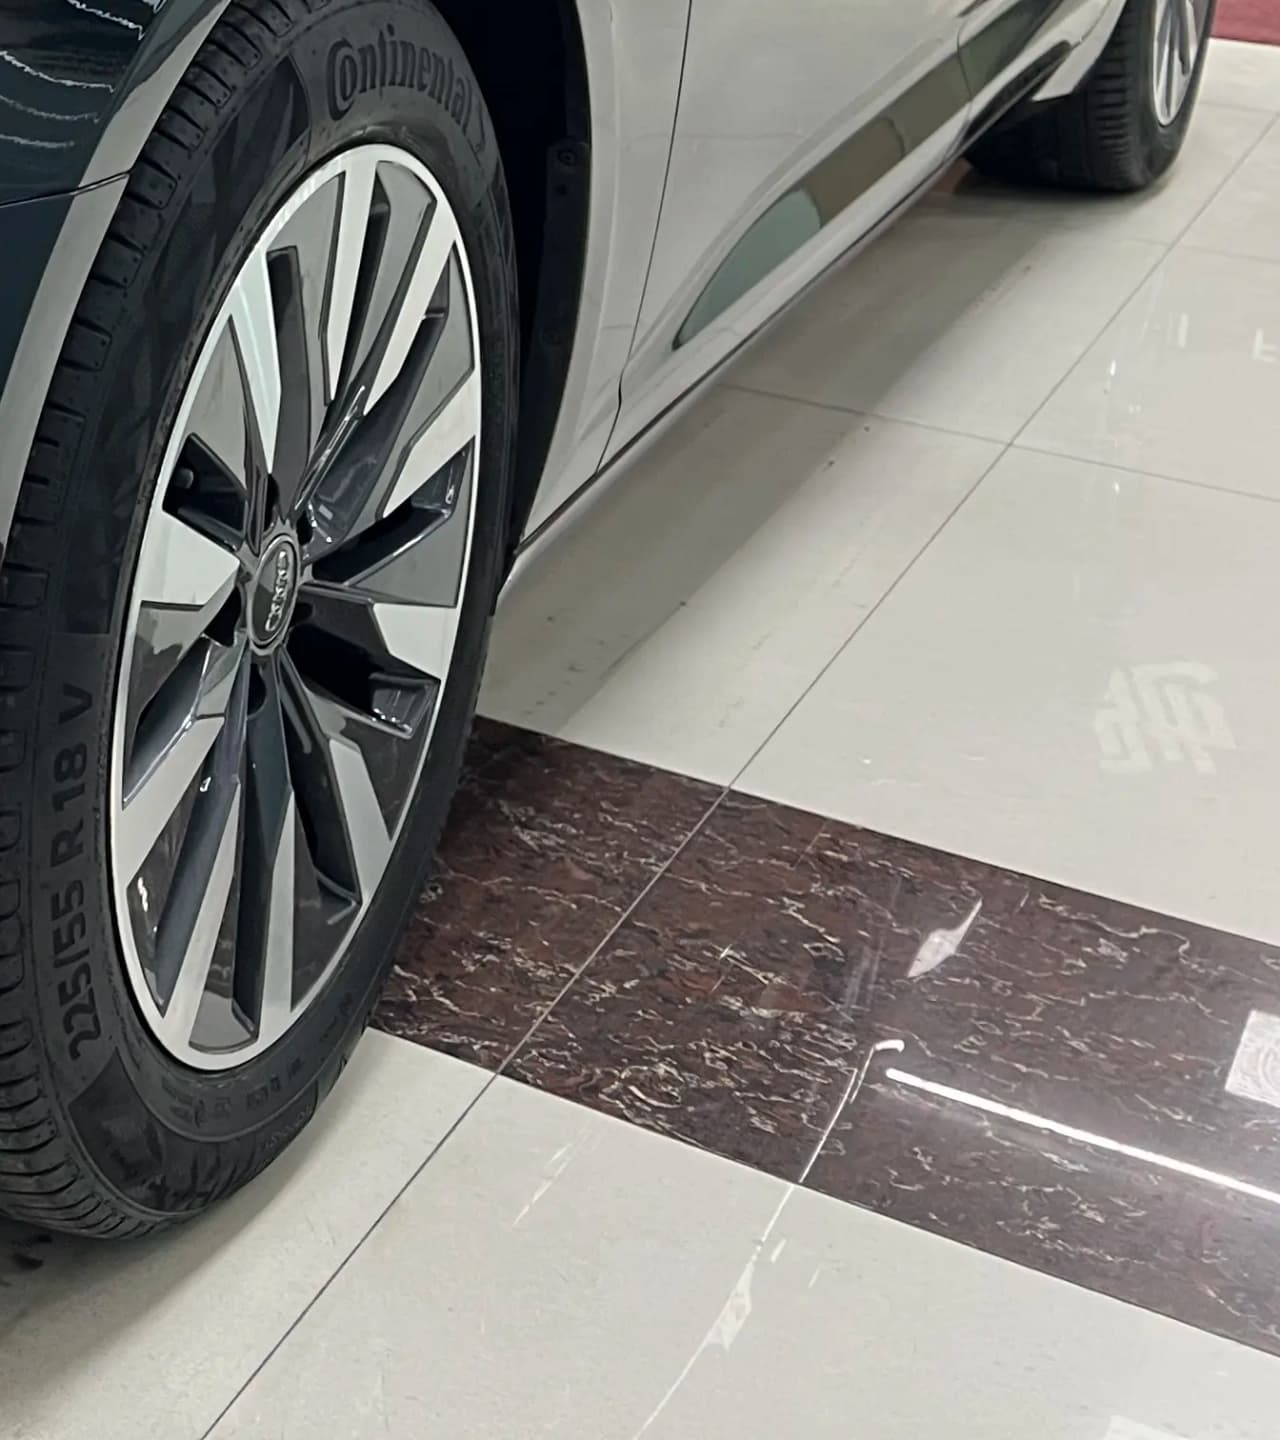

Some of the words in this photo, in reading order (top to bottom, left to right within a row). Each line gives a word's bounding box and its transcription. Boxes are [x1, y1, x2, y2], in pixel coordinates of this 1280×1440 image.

[326, 23, 474, 136] Continental
[59, 684, 93, 725] V
[53, 743, 88, 813] 18
[52, 822, 84, 867] R
[53, 879, 101, 1059] 225/55
